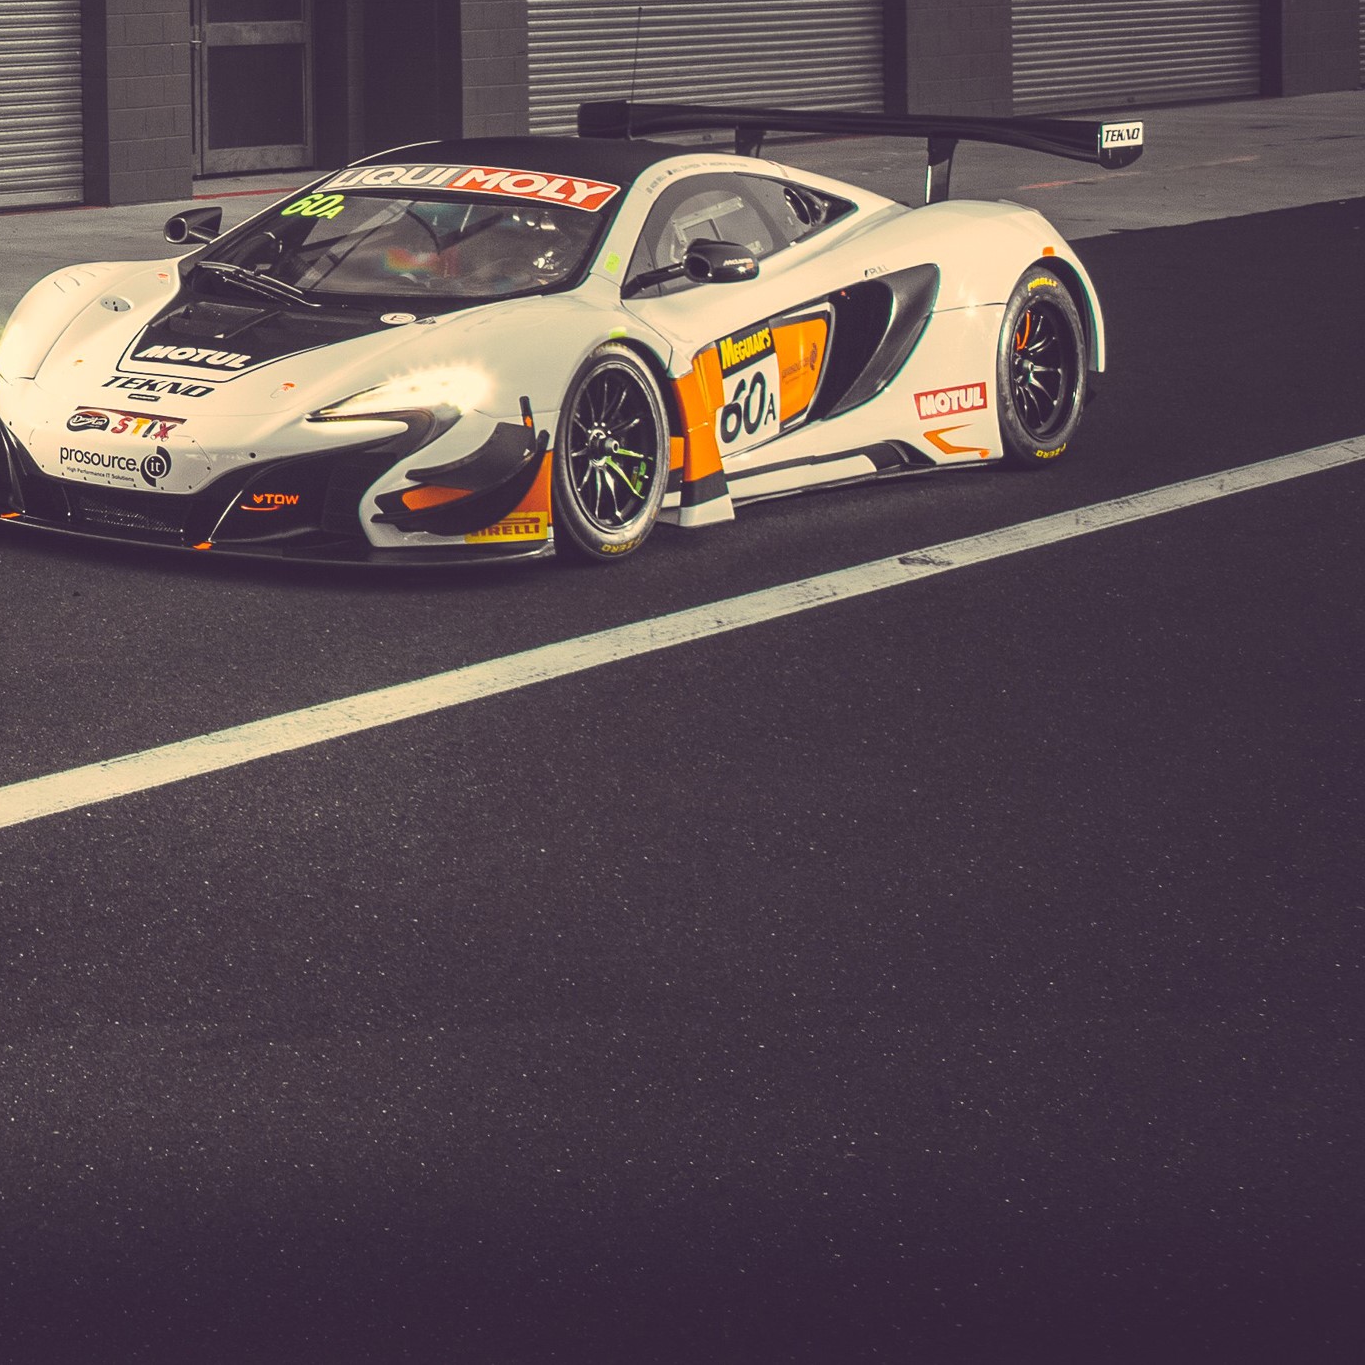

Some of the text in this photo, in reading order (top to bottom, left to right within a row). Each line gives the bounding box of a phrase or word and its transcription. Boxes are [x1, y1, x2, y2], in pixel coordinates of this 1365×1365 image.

[1105, 128, 1140, 142] TEKNO
[334, 167, 613, 204] LIQUI MOLY
[135, 345, 251, 369] MOTUL
[102, 376, 215, 397] TEKNO
[919, 387, 985, 417] MOTUL
[111, 416, 177, 442] STIX
[265, 493, 300, 505] TOW
[470, 523, 540, 537] IRELLI
